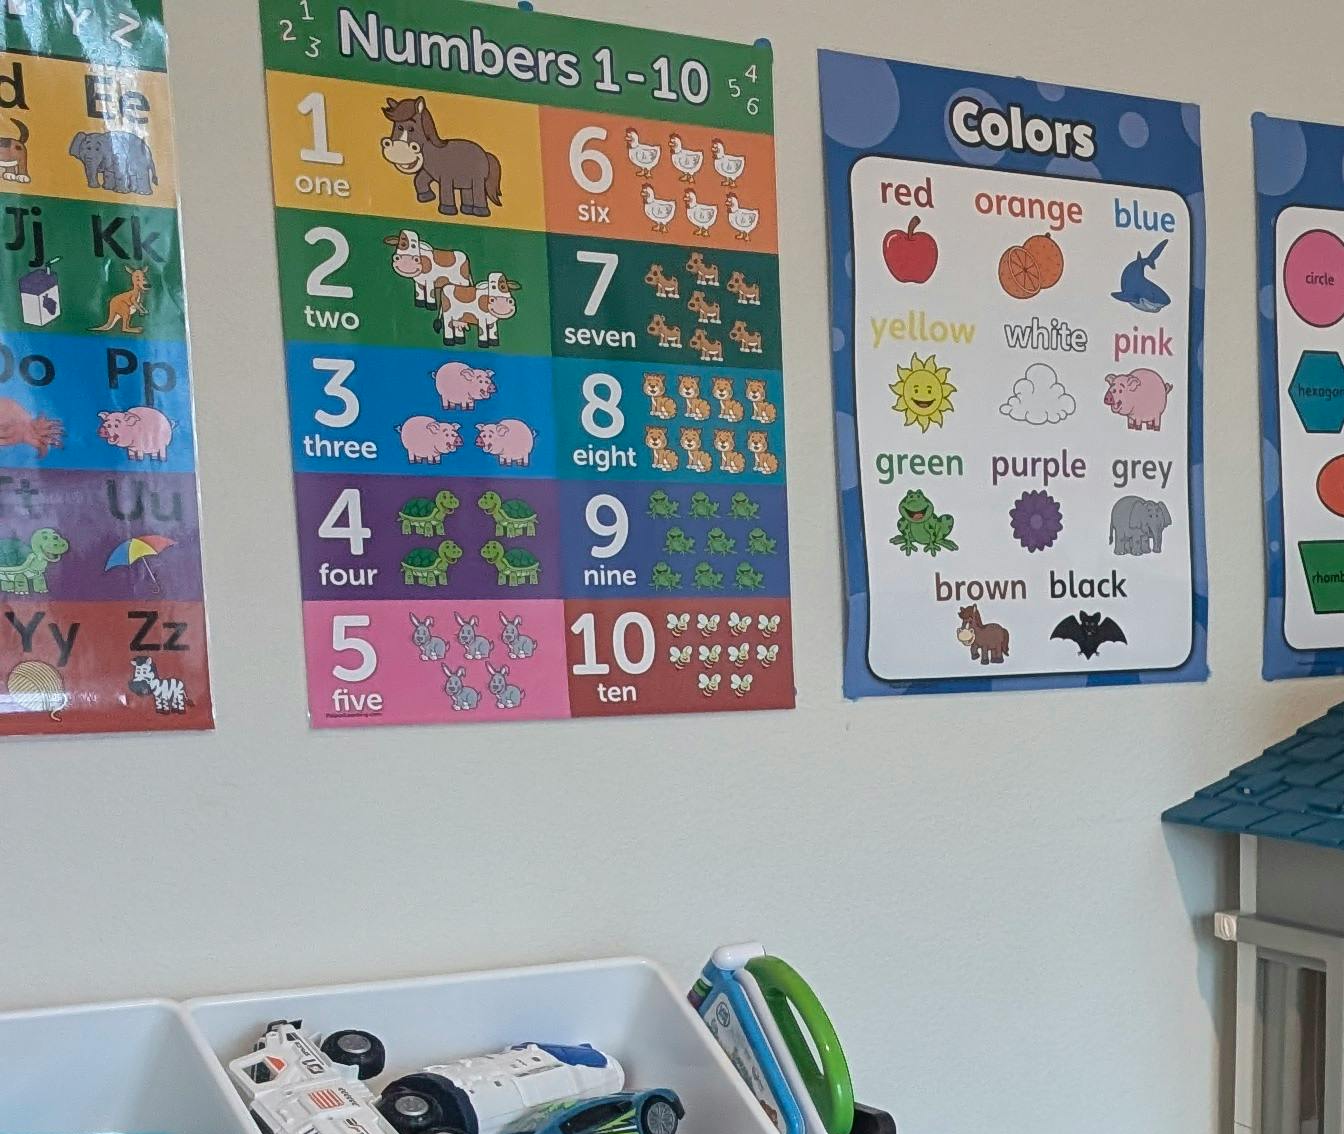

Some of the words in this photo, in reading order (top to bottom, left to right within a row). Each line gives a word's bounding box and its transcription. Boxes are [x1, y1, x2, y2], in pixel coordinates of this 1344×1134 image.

[300, 0, 314, 20] 1
[280, 20, 296, 41] 2
[305, 36, 321, 57] 3
[338, 9, 579, 88] Numbers
[592, 47, 712, 105] 1-10
[745, 65, 757, 83] 4
[0, 62, 29, 111] d
[85, 74, 151, 124] Ee
[728, 79, 740, 97] 5
[747, 98, 759, 115] 6
[297, 92, 344, 165] 1
[950, 99, 1097, 159] Colors
[568, 127, 613, 193] 6
[295, 172, 352, 199] one
[880, 176, 935, 209] red
[578, 199, 610, 225] six
[974, 191, 1083, 232] orange
[1115, 198, 1176, 233] blue
[5, 206, 46, 267] Jj
[91, 213, 165, 263] Kk
[304, 226, 354, 300] 2
[1305, 272, 1335, 286] circle
[576, 250, 619, 316] 7
[304, 305, 360, 330] two
[871, 311, 976, 348] yellow
[1004, 317, 1088, 352] white
[564, 326, 637, 349] seven
[1114, 327, 1174, 362] pink
[107, 347, 177, 405] Pp
[312, 358, 360, 428] 3
[581, 373, 626, 439] 8
[304, 434, 378, 460] three
[573, 445, 637, 472] eight
[876, 453, 964, 484] green
[992, 449, 1087, 486] purple
[1112, 457, 1173, 489] grey
[106, 479, 182, 522] Uu
[317, 488, 372, 556] 4
[585, 494, 629, 558] 9
[319, 563, 378, 588] four
[584, 566, 637, 587] nine
[935, 572, 1027, 602] brown
[1050, 570, 1128, 599] black
[5, 611, 80, 667] Yy
[128, 611, 190, 651] Zz
[571, 611, 655, 676] 10
[332, 615, 377, 683] 5
[332, 690, 383, 711] five
[597, 683, 637, 703] ten
